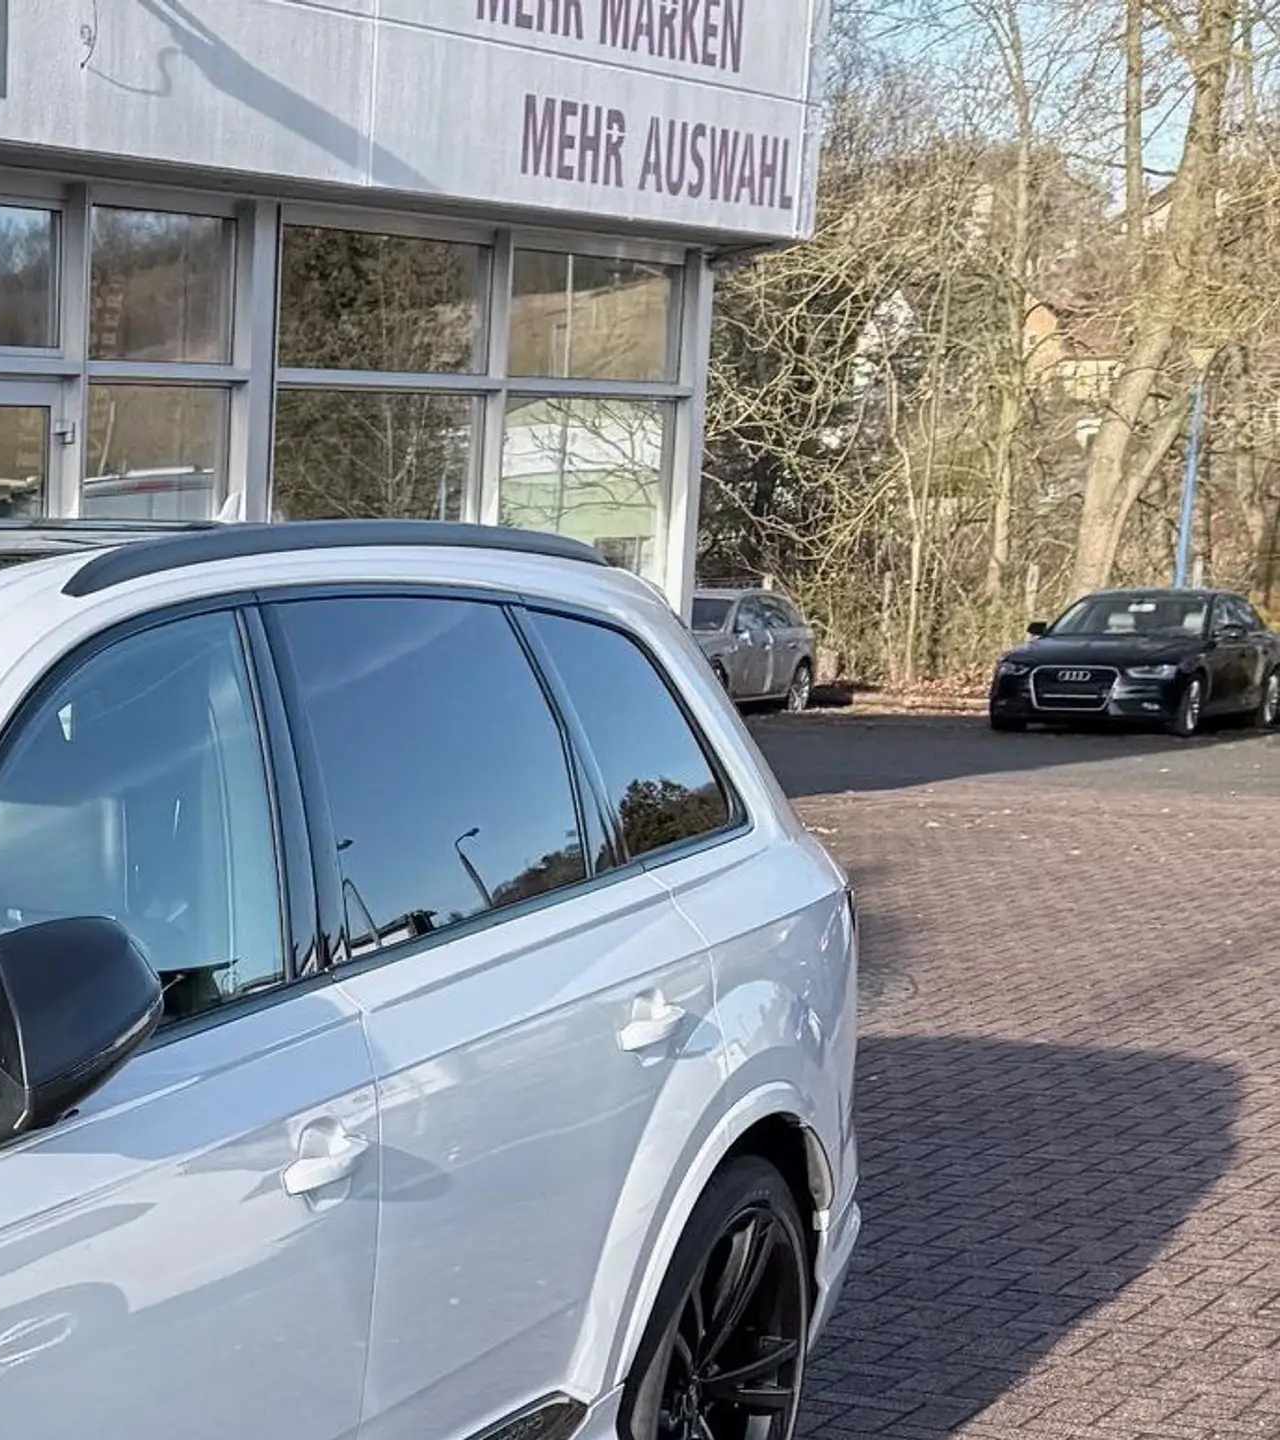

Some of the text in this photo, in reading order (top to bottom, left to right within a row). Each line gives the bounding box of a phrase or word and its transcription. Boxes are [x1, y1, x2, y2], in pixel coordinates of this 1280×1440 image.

[600, 0, 743, 72] MARKEN
[521, 94, 793, 209] MEHR AUSWAHL
